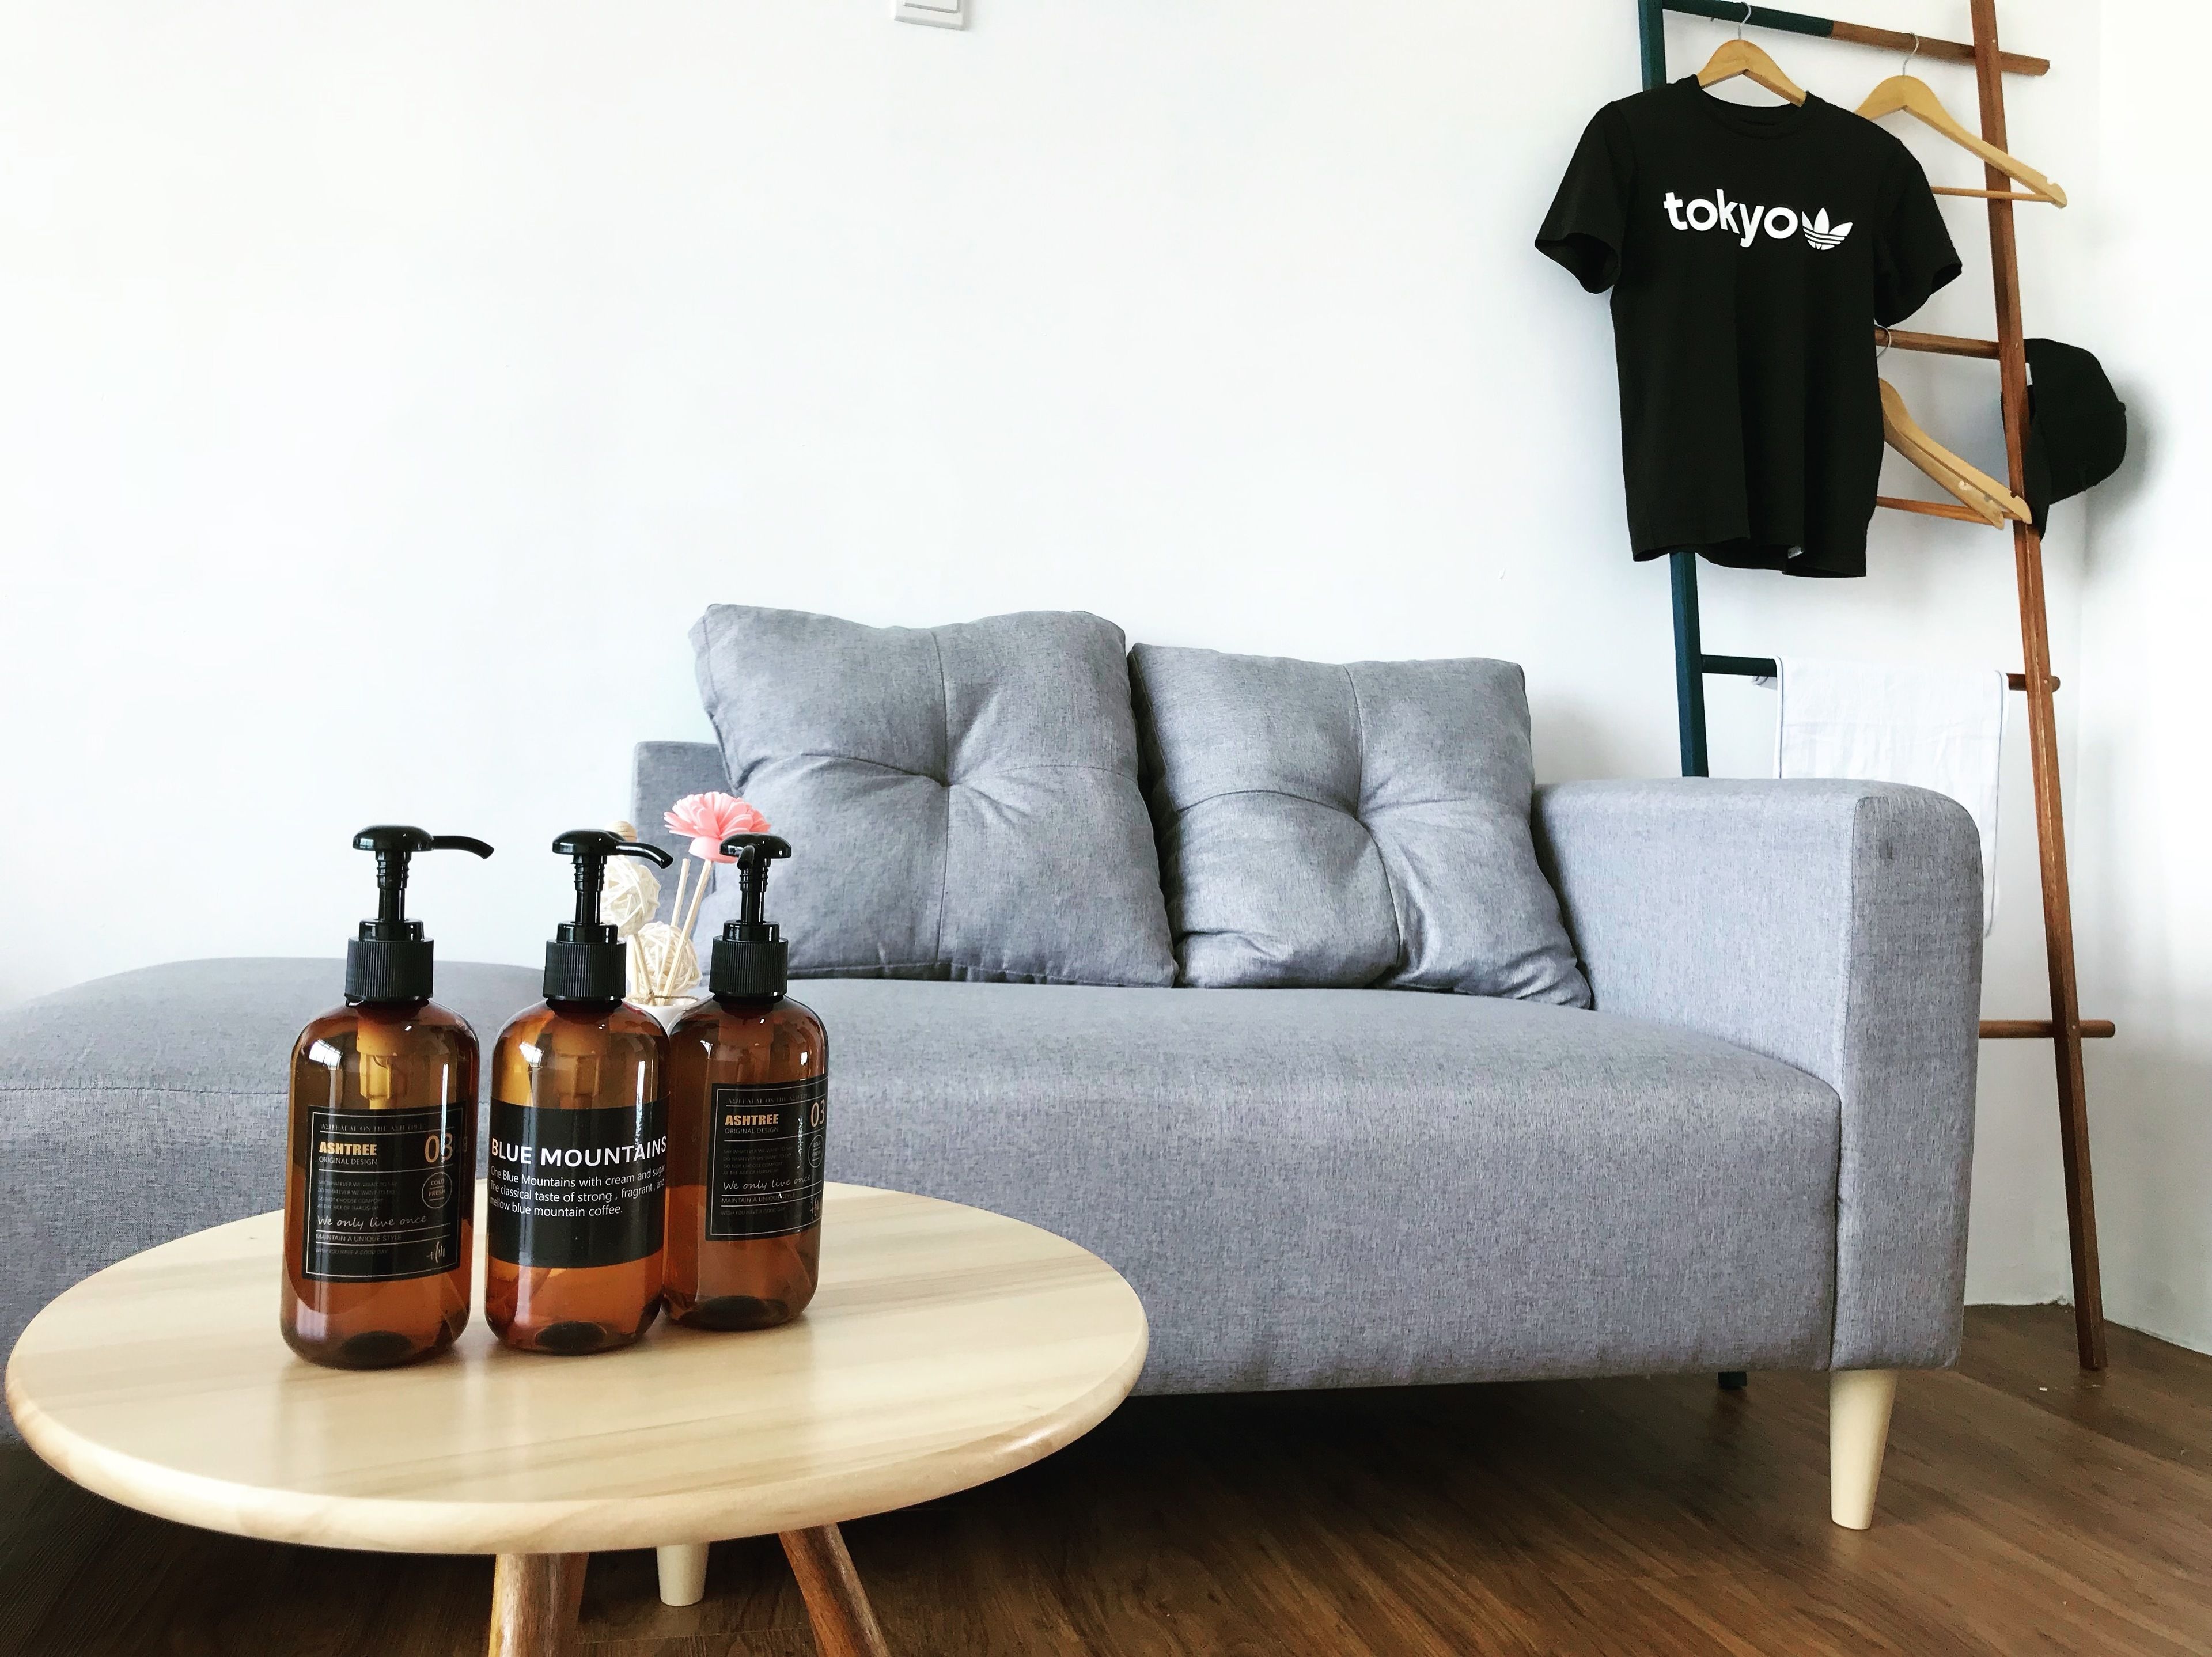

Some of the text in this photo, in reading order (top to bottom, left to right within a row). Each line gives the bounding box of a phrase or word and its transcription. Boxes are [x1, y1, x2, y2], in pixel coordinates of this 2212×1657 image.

[1664, 189, 1798, 248] tokyo
[724, 1113, 779, 1126] ASHTREE
[810, 1099, 825, 1128] 03
[319, 1141, 378, 1156] ASHTREE
[491, 1135, 667, 1167] BLUE MOUNTAINS
[319, 1155, 349, 1165] ORIGINAL
[491, 1165, 502, 1179] One
[502, 1170, 519, 1184] Blue
[521, 1174, 576, 1188] Mountains
[579, 1176, 602, 1187] with
[605, 1174, 635, 1186] cream
[637, 1168, 651, 1181] and
[723, 1175, 811, 1190] We only live once
[490, 1180, 499, 1193] The
[500, 1185, 532, 1200] classical
[535, 1191, 560, 1202] taste
[563, 1192, 575, 1202] of
[578, 1192, 612, 1203] strong
[512, 1201, 531, 1215] blue
[534, 1207, 585, 1216] mountain
[589, 1204, 623, 1216] coffee.
[317, 1215, 427, 1230] We only live once
[354, 1235, 381, 1243] UNIQUE
[382, 1234, 402, 1242] STYLE
